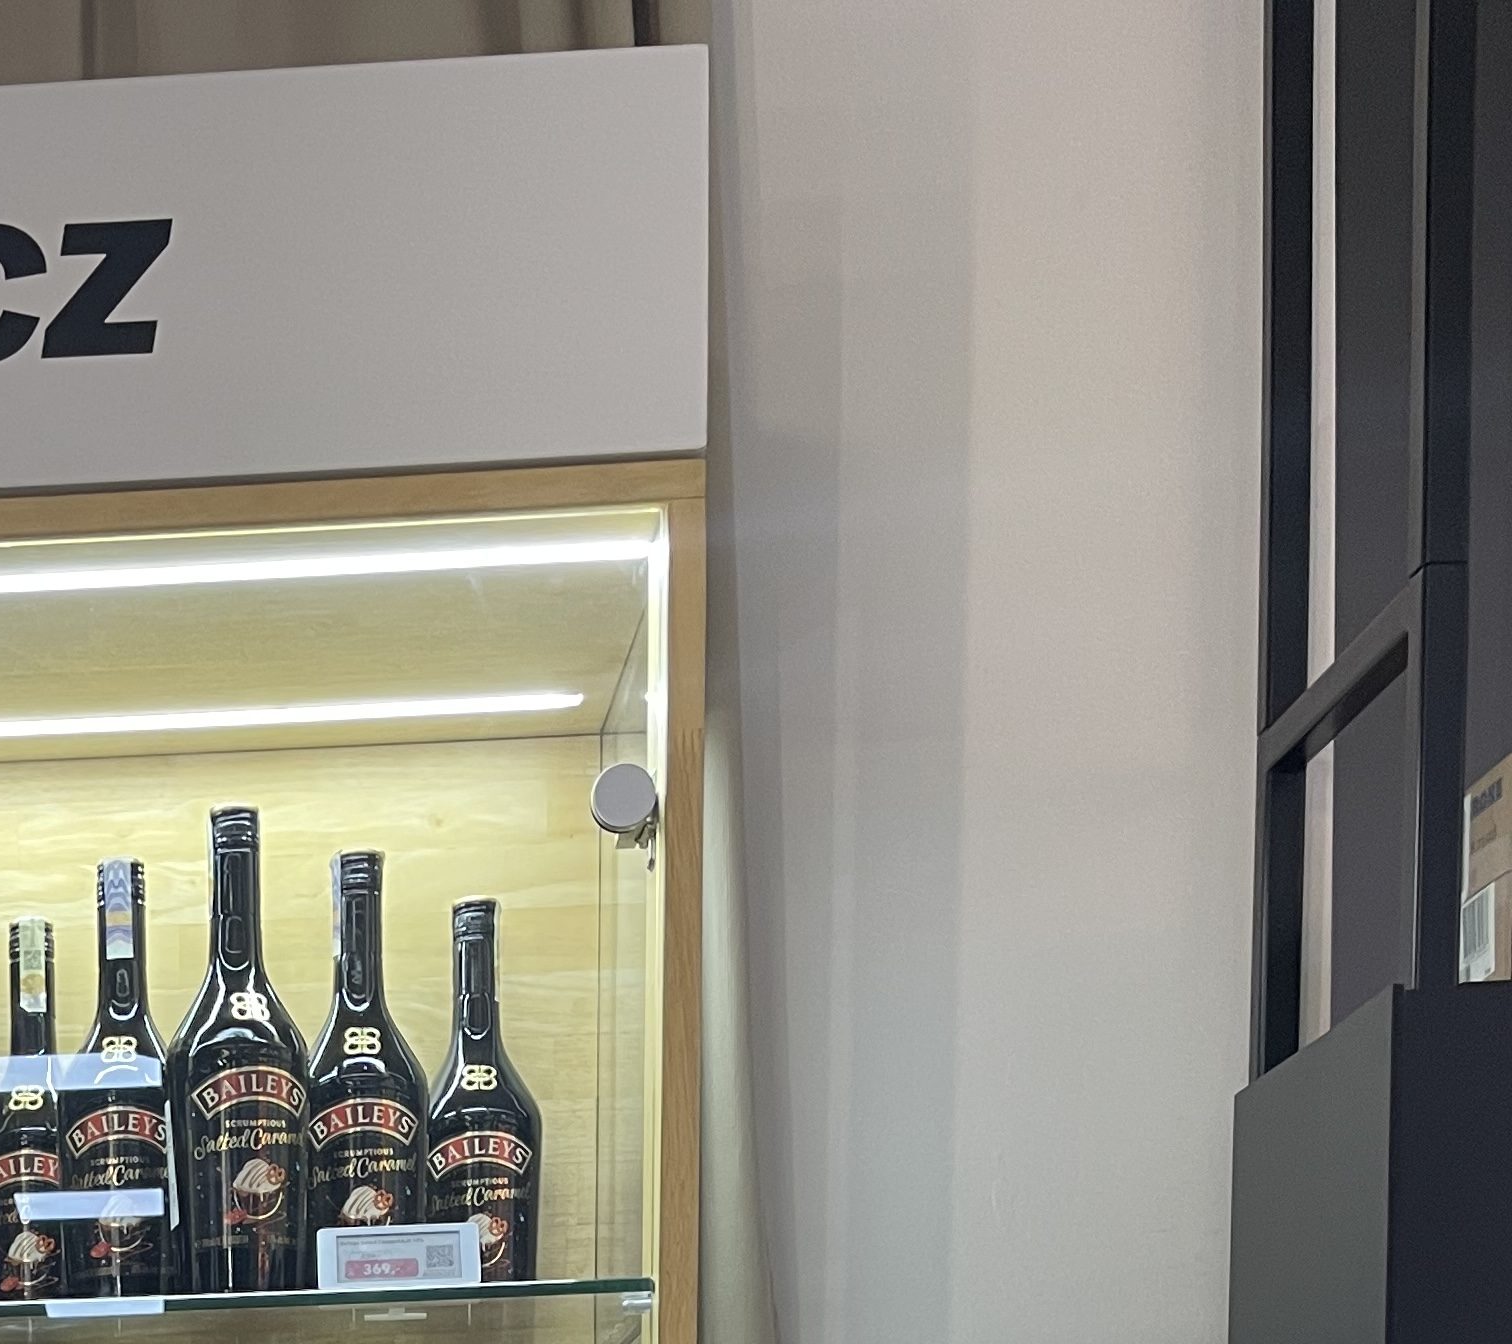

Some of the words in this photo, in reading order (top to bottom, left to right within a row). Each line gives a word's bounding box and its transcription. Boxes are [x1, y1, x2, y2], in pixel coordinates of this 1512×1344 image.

[201, 1073, 304, 1106] BAILEYS
[73, 1111, 167, 1148] BAILEYS
[314, 1105, 410, 1140] BAILEYS
[432, 1138, 523, 1170] BAILEYS
[363, 1263, 400, 1275] 369,-
